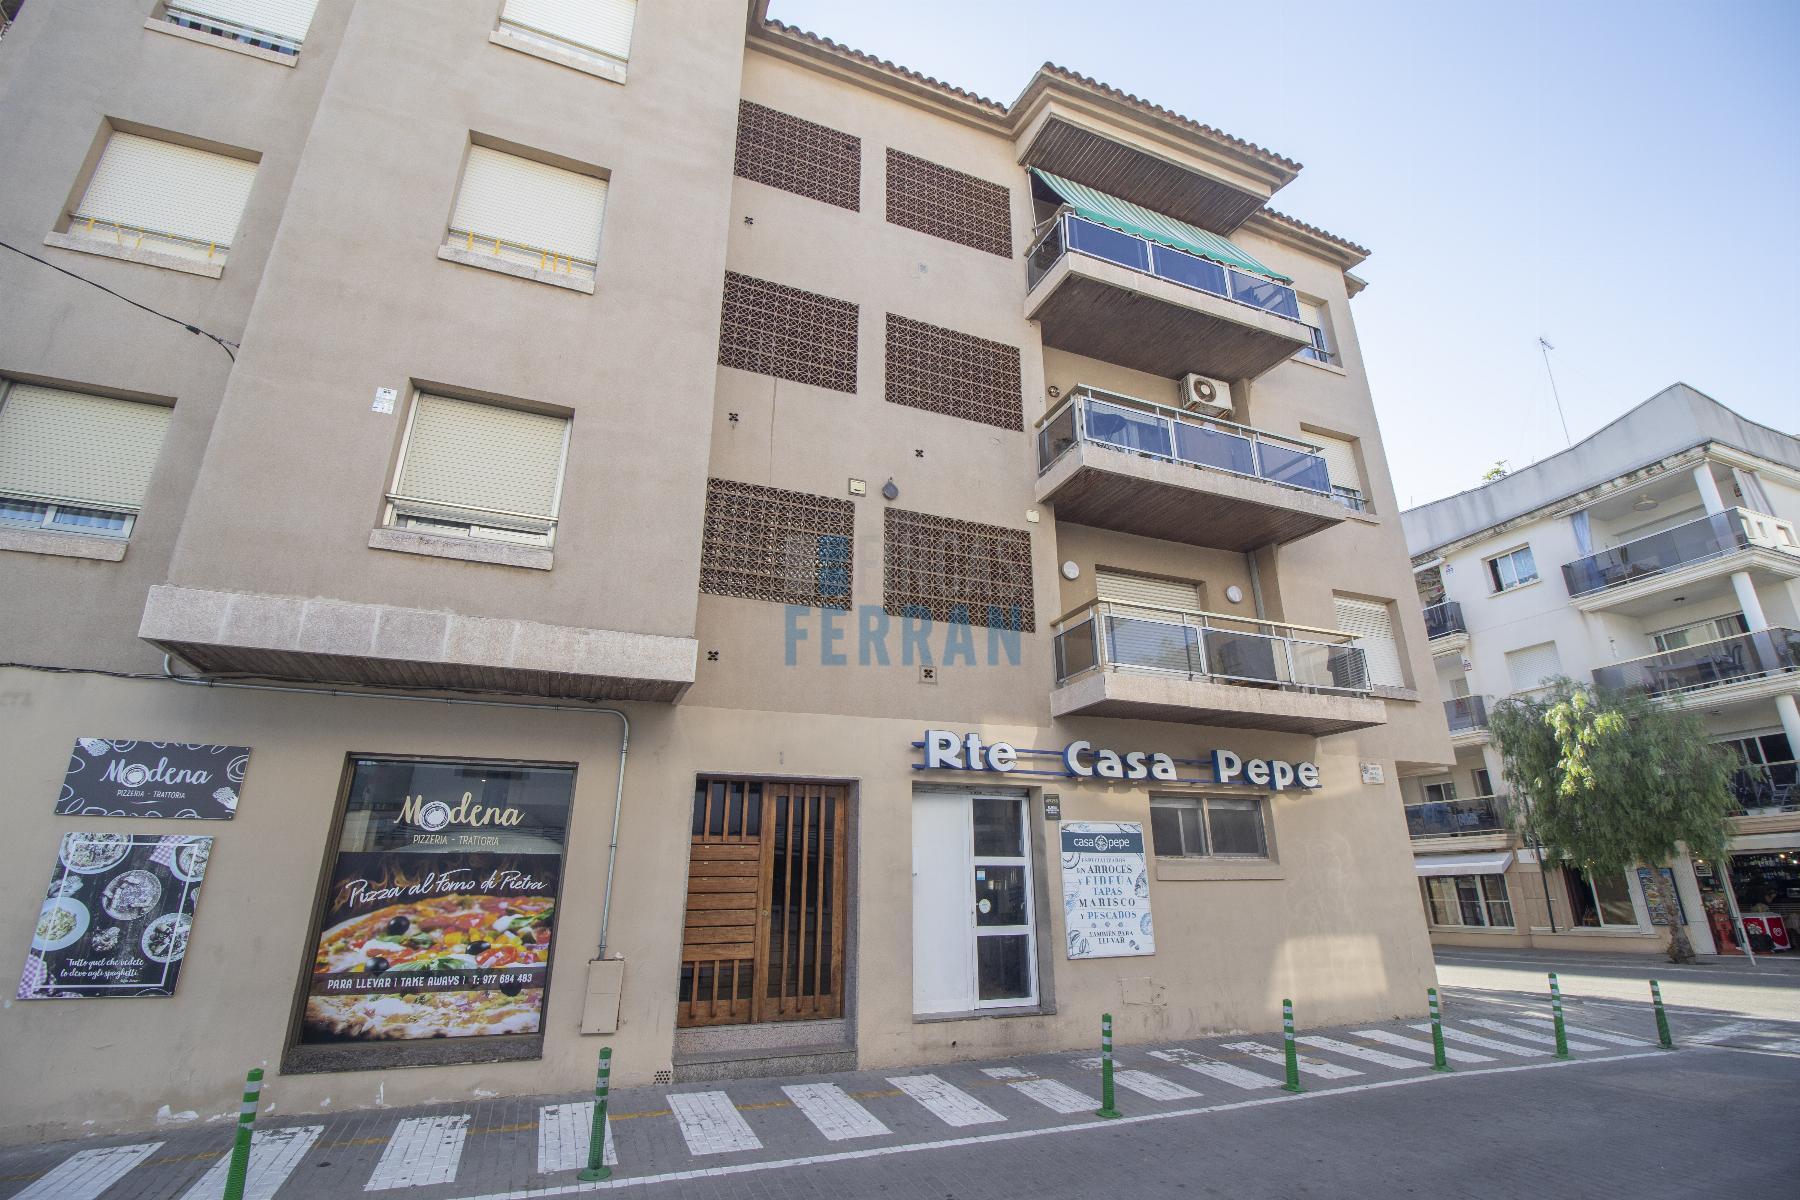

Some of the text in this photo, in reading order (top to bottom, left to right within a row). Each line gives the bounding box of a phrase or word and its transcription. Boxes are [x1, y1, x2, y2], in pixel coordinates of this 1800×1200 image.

[924, 729, 1320, 791] Rte Casa Pepe
[100, 757, 214, 787] Modena
[153, 791, 185, 799] TRATTORIA
[393, 791, 526, 831] Modena
[413, 834, 448, 845] PIZZERIA
[459, 835, 499, 846] TRATTORIA
[1073, 838, 1130, 849] casa pepe
[1088, 865, 1133, 874] ARROCES
[346, 879, 407, 907] Pizza
[409, 872, 435, 895] al
[480, 869, 499, 893] di
[500, 870, 549, 890] Pietra
[1093, 887, 1123, 896] TAPAS
[1079, 898, 1135, 907] MARISCO
[1087, 911, 1137, 920] PESCADOS
[120, 957, 144, 966] vedete
[60, 969, 68, 977] lo
[69, 968, 86, 977] devo
[87, 969, 103, 979] agli
[327, 979, 353, 990] PARA
[355, 978, 392, 988] LLEVAR
[400, 977, 425, 987] TAKE
[427, 975, 460, 986] AWAYS
[472, 975, 480, 984] T:
[482, 974, 498, 984] 977
[499, 974, 515, 984] 684
